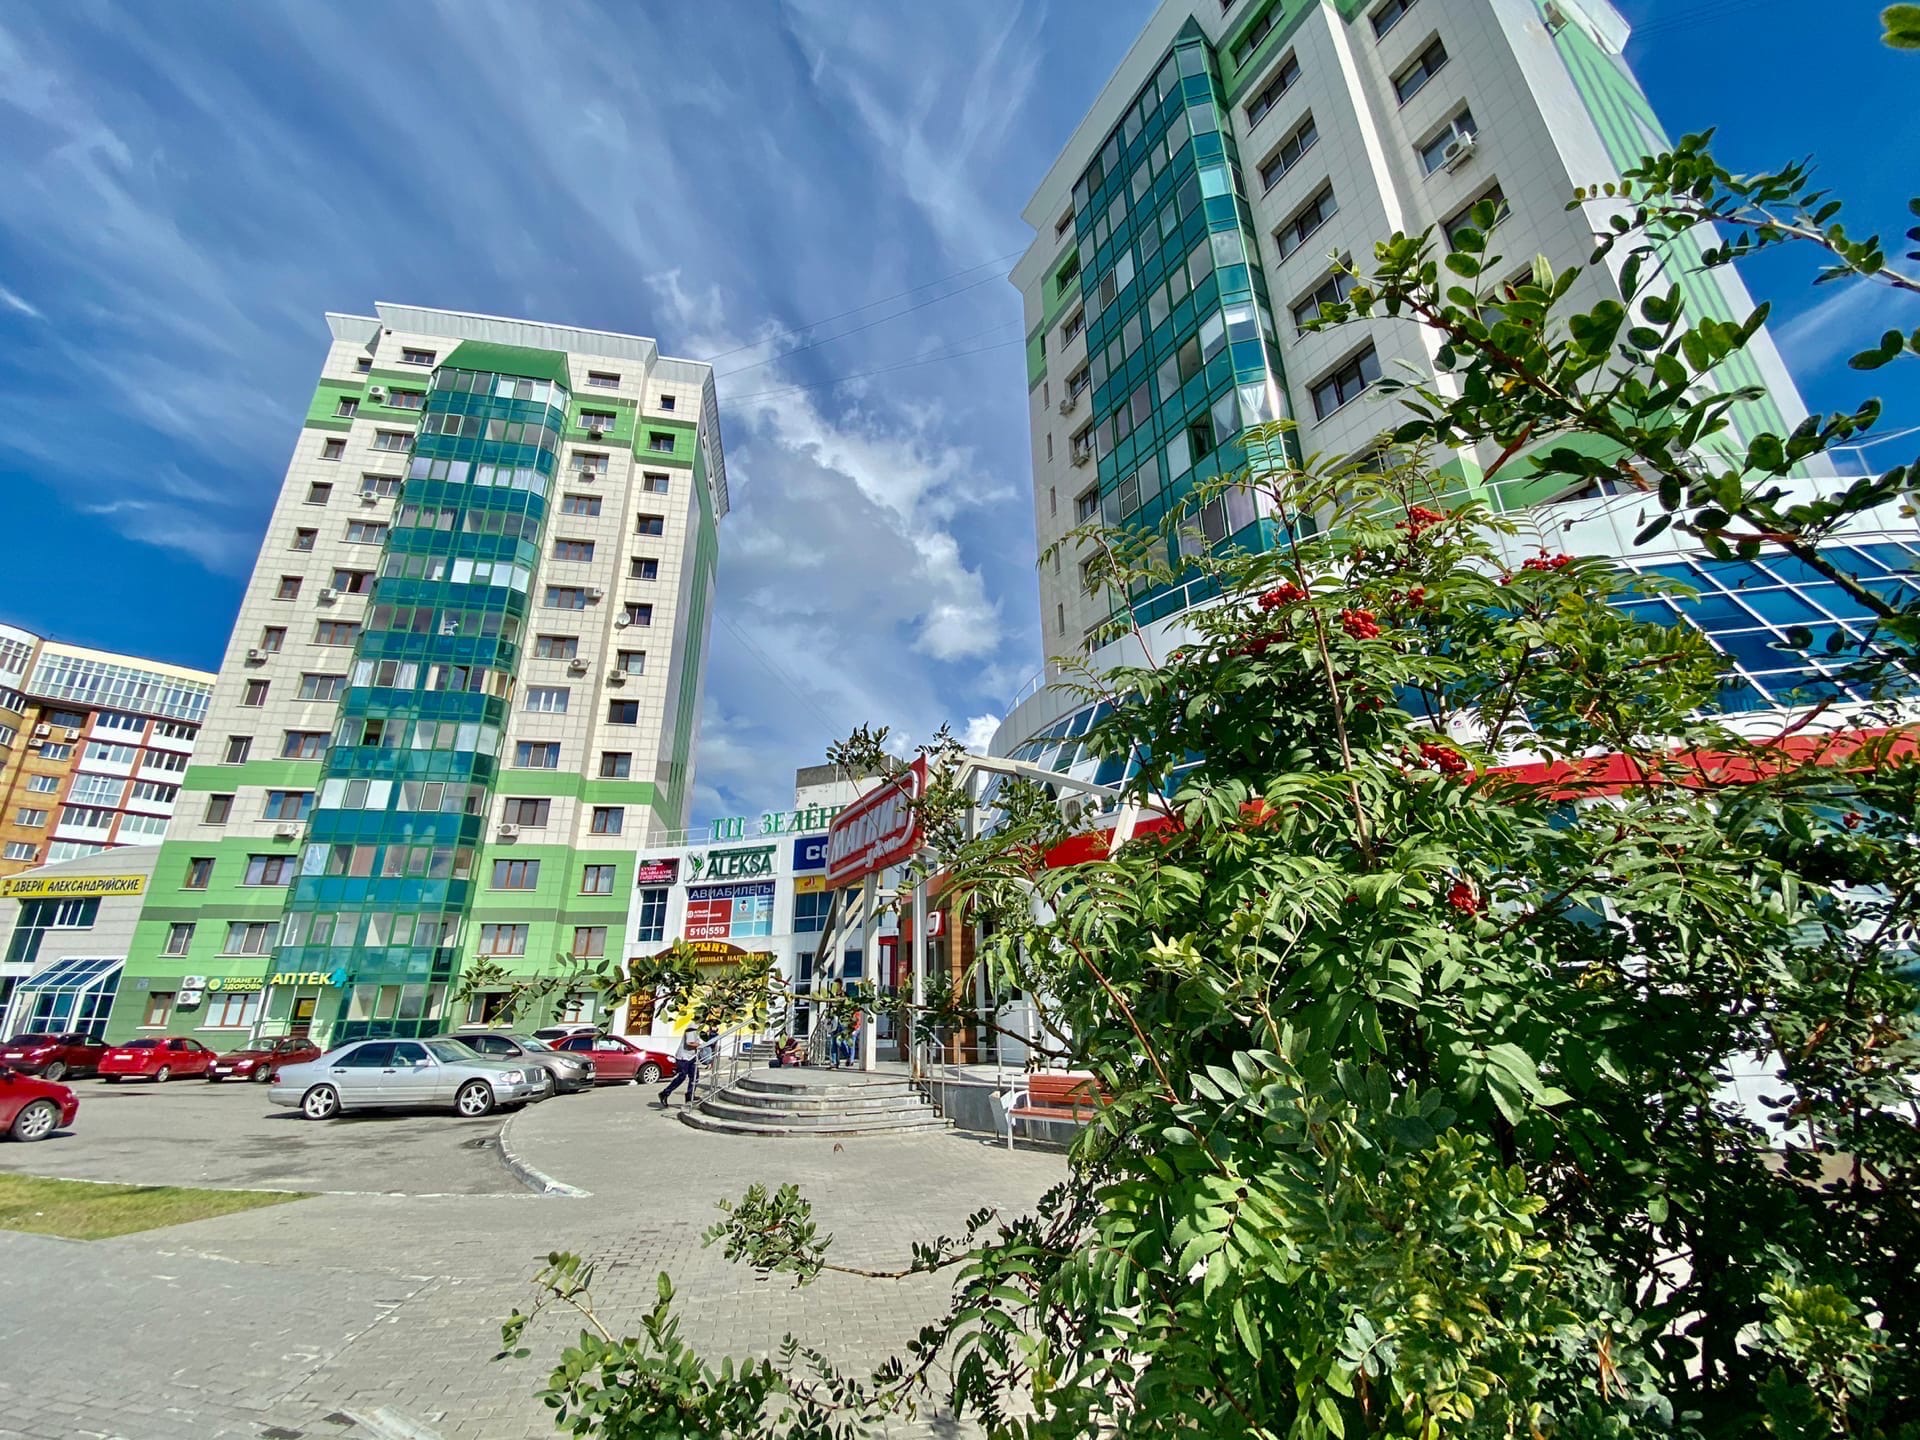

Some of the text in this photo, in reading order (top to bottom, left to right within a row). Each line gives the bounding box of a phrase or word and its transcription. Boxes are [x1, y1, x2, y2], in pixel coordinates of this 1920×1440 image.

[712, 816, 745, 840] ТЦ
[831, 787, 913, 864] МАГНИТ
[706, 853, 772, 878] ALEKSA
[13, 878, 140, 892] ДВЕРИ АЛЕКСАНДРИЙСКИЕ
[690, 884, 774, 899] АВИАБИЛЕТЫ
[270, 972, 335, 985] АПТЕК
